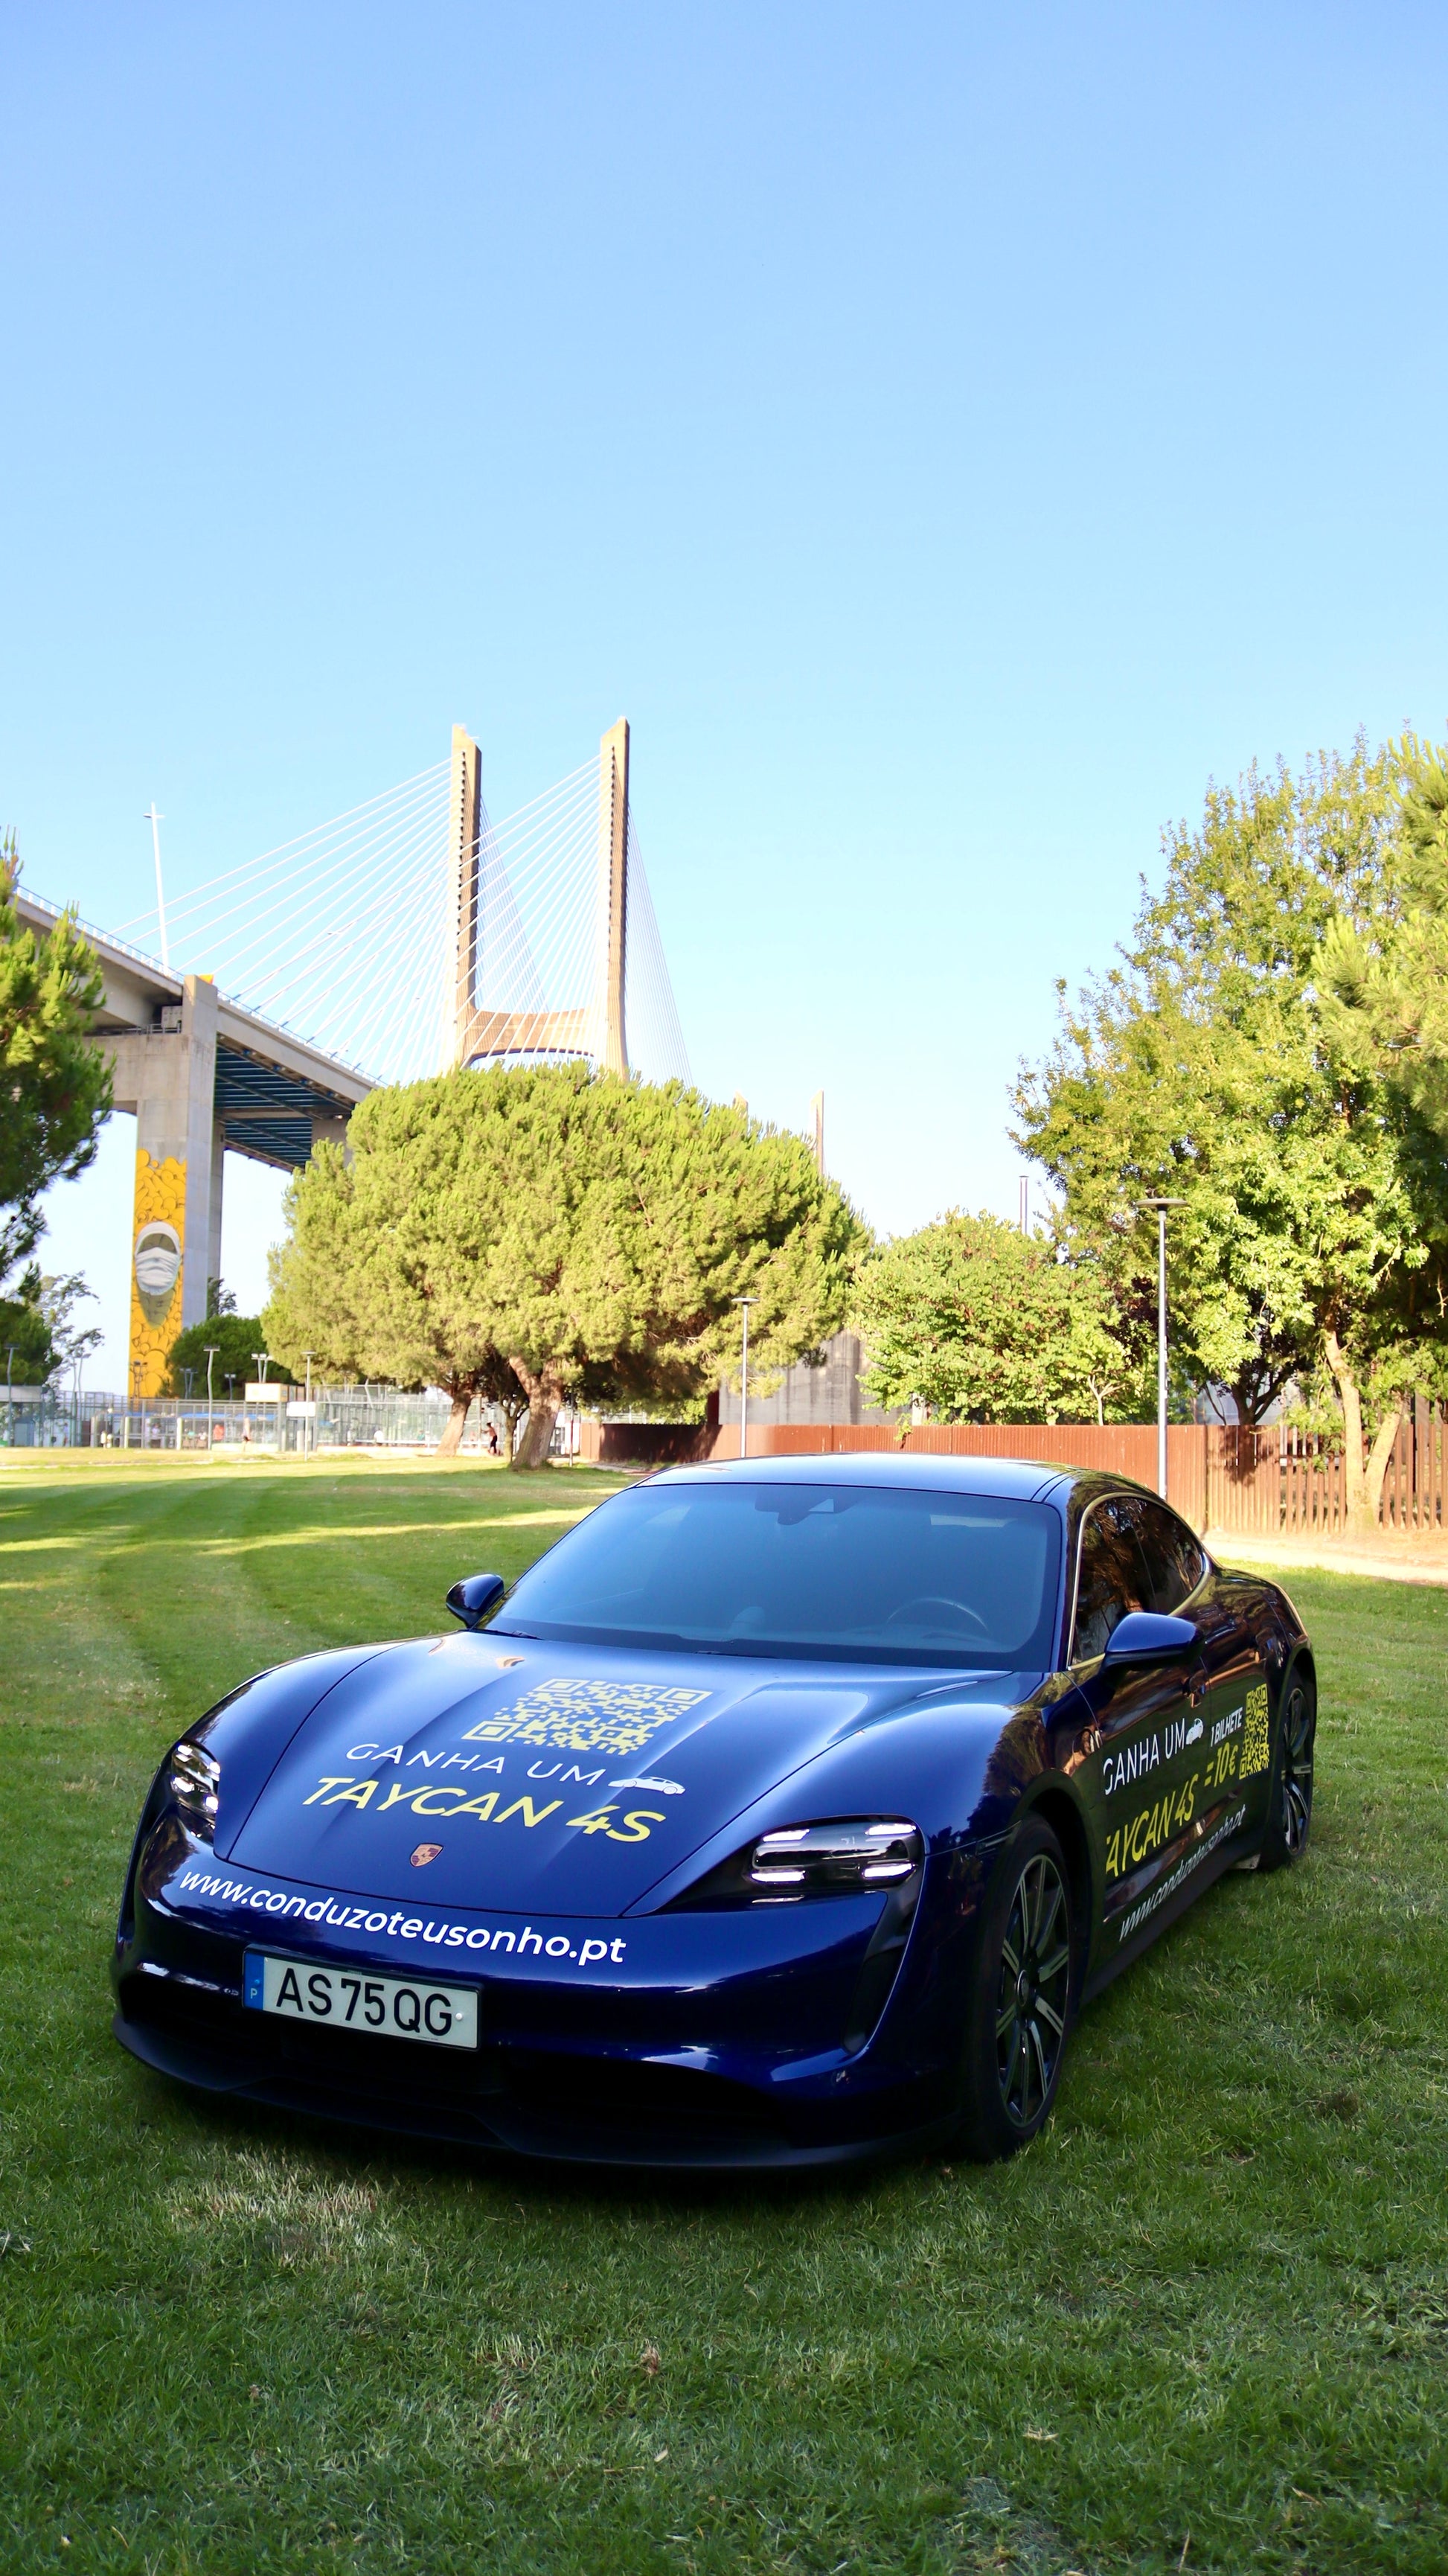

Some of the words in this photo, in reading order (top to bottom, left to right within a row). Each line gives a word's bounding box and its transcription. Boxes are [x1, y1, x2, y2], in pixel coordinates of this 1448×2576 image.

[346, 1743, 505, 1774] GANHA
[526, 1760, 606, 1786] UM
[1165, 1717, 1185, 1760] UM
[302, 1777, 564, 1828] TAYCAN
[566, 1805, 667, 1843] 4S
[1106, 1790, 1176, 1878] AYCAN
[1174, 1773, 1199, 1827] 4S
[179, 1871, 627, 1966] www.conduzoteusonho.pt
[250, 1987, 257, 1999] P
